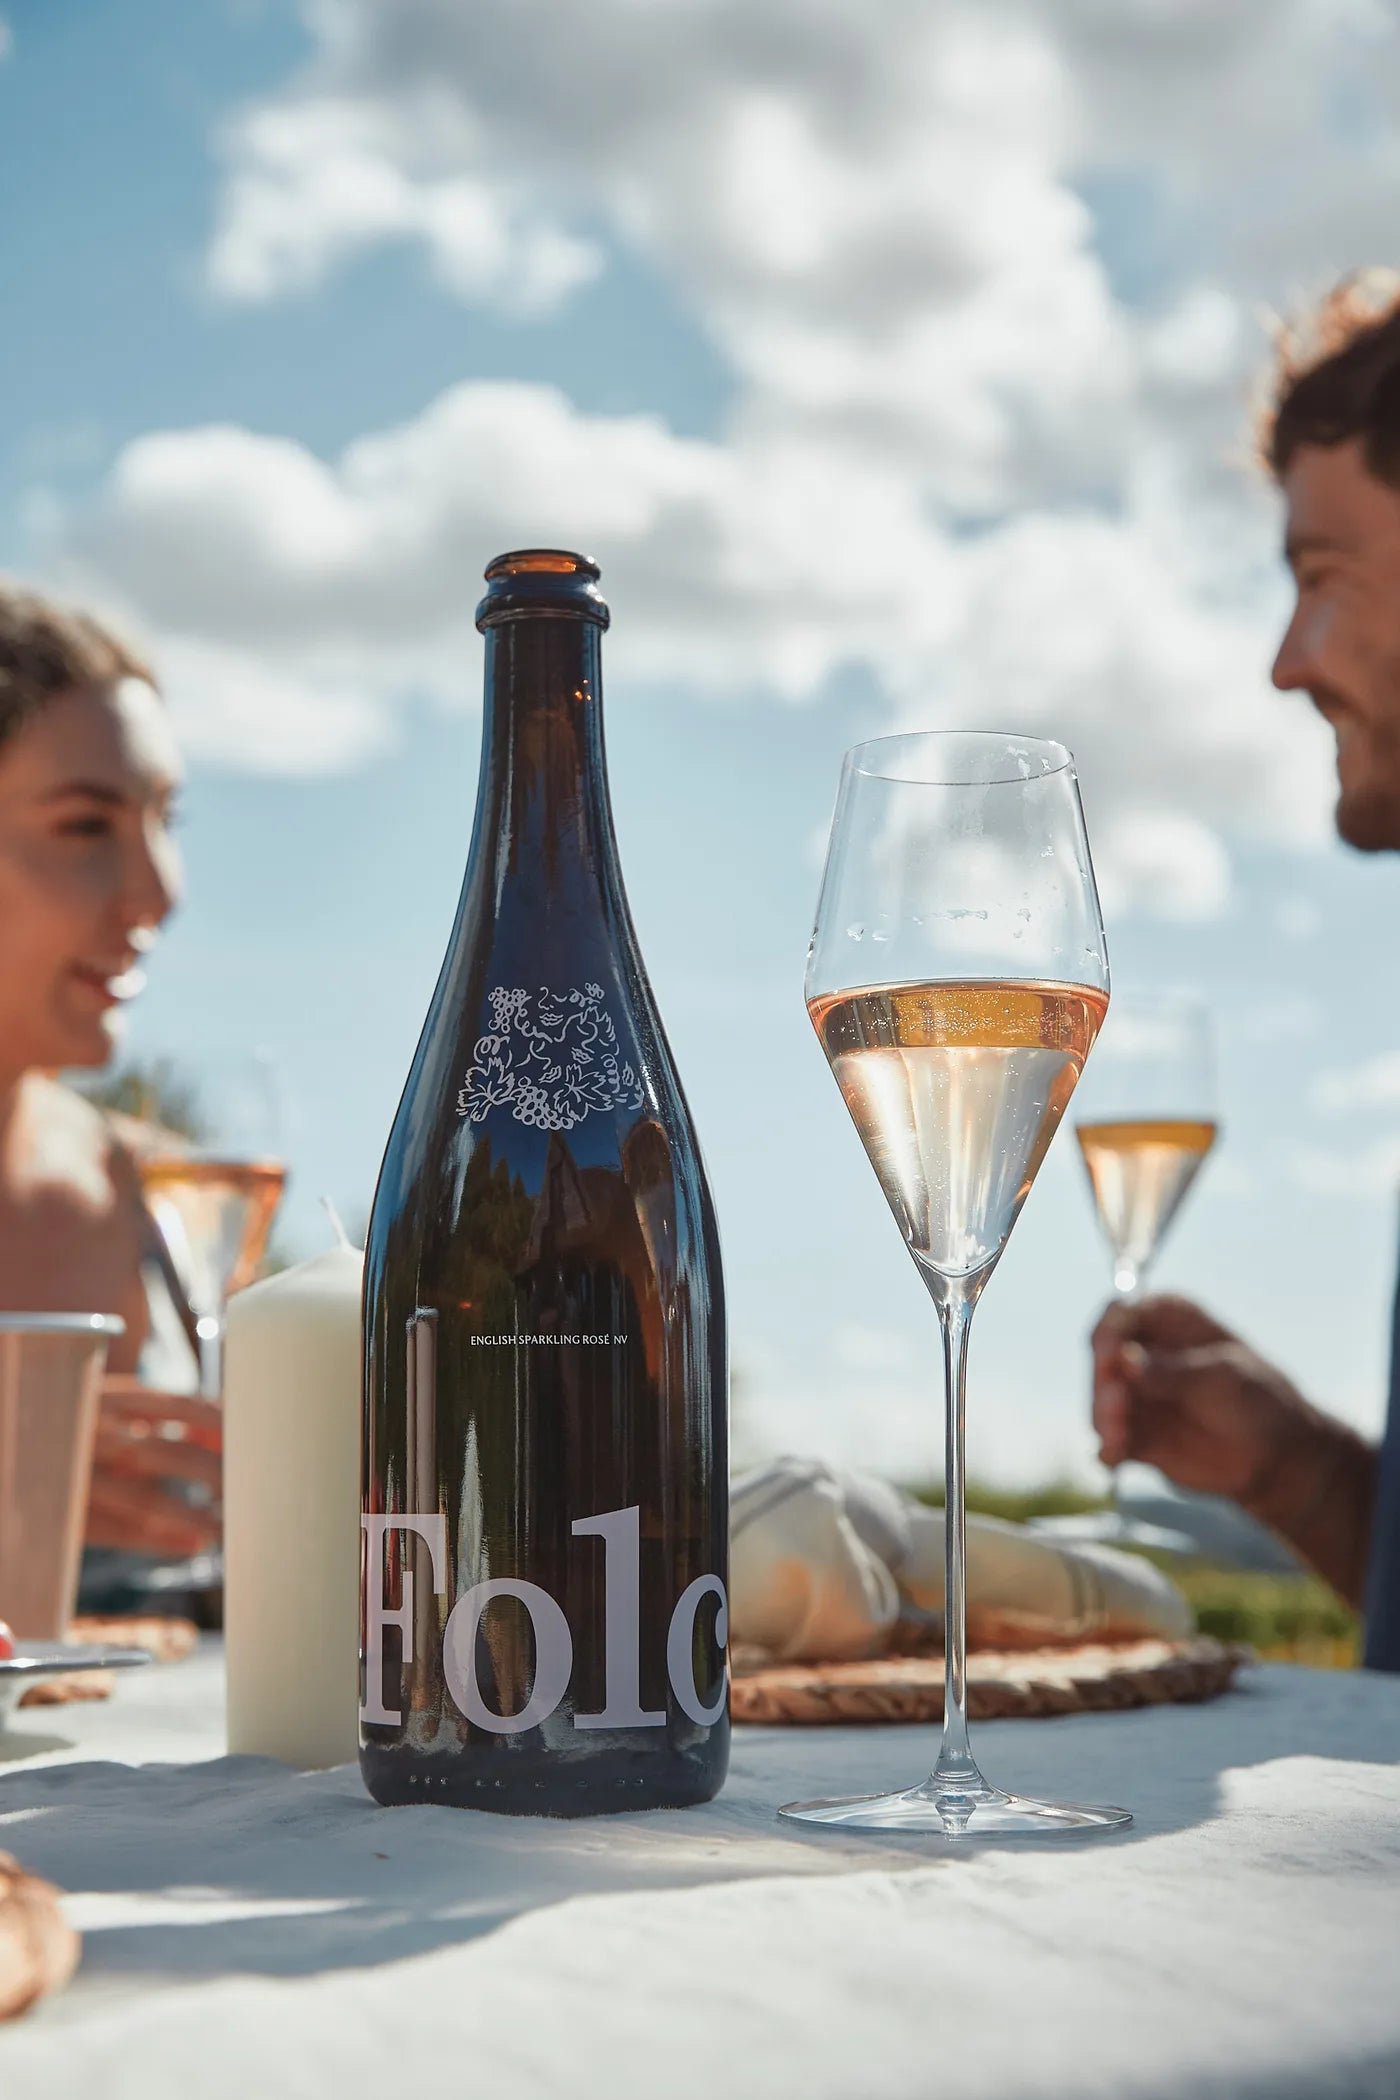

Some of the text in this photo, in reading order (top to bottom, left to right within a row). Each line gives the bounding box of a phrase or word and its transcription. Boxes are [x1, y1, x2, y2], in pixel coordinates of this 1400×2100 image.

[470, 1333, 628, 1346] ENGLISH SPARKLING ROSÉ NV
[361, 1505, 728, 1735] Folc
